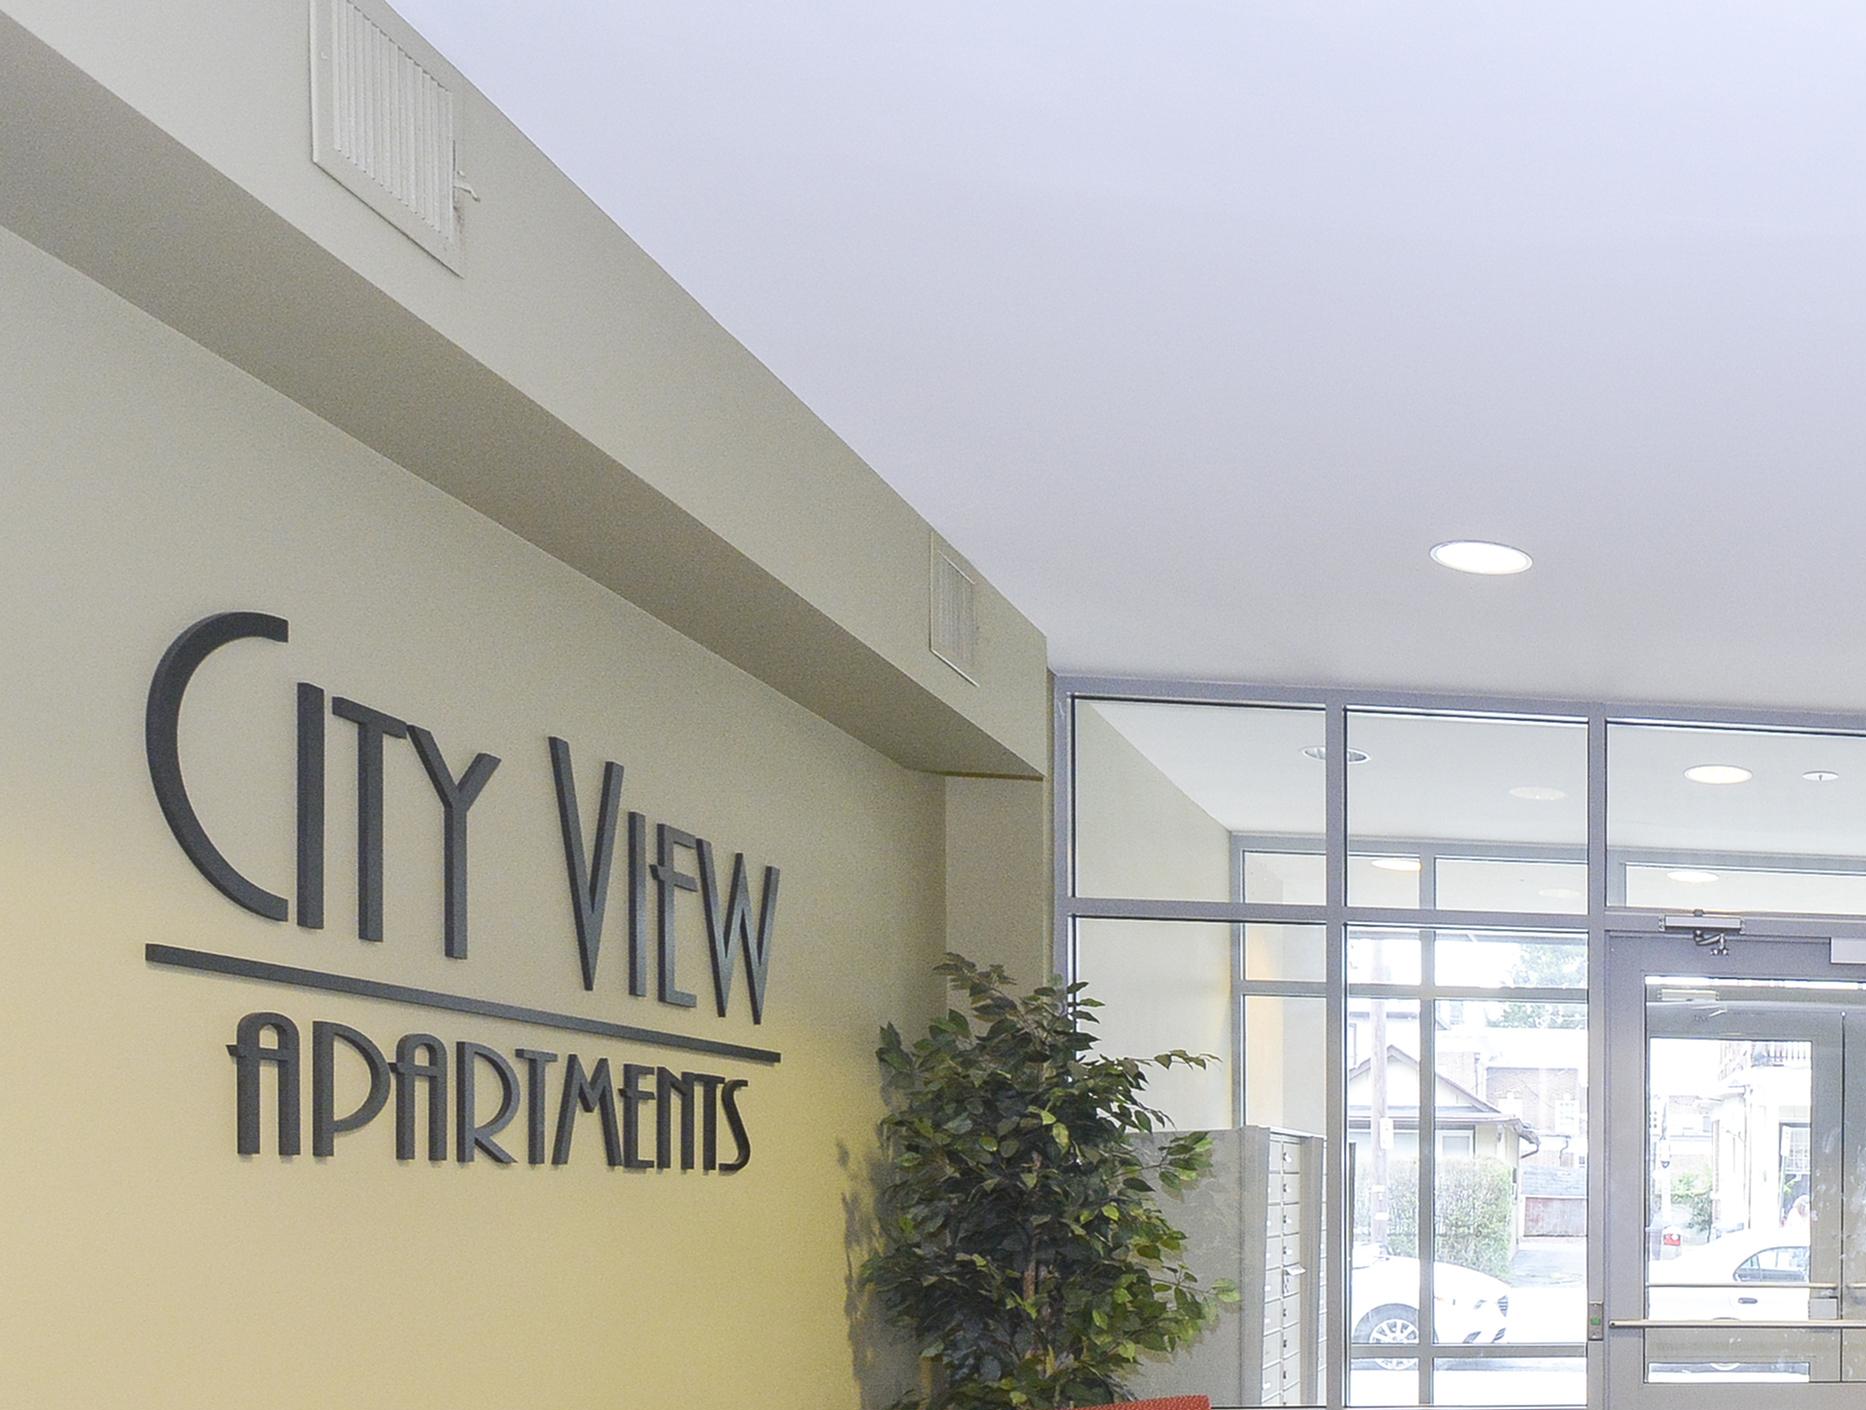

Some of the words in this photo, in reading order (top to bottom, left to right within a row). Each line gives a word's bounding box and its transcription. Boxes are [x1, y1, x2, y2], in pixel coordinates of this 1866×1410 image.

[145, 611, 502, 960] CITY
[547, 736, 781, 1026] VIEW
[226, 1011, 752, 1175] APARTMENTS
